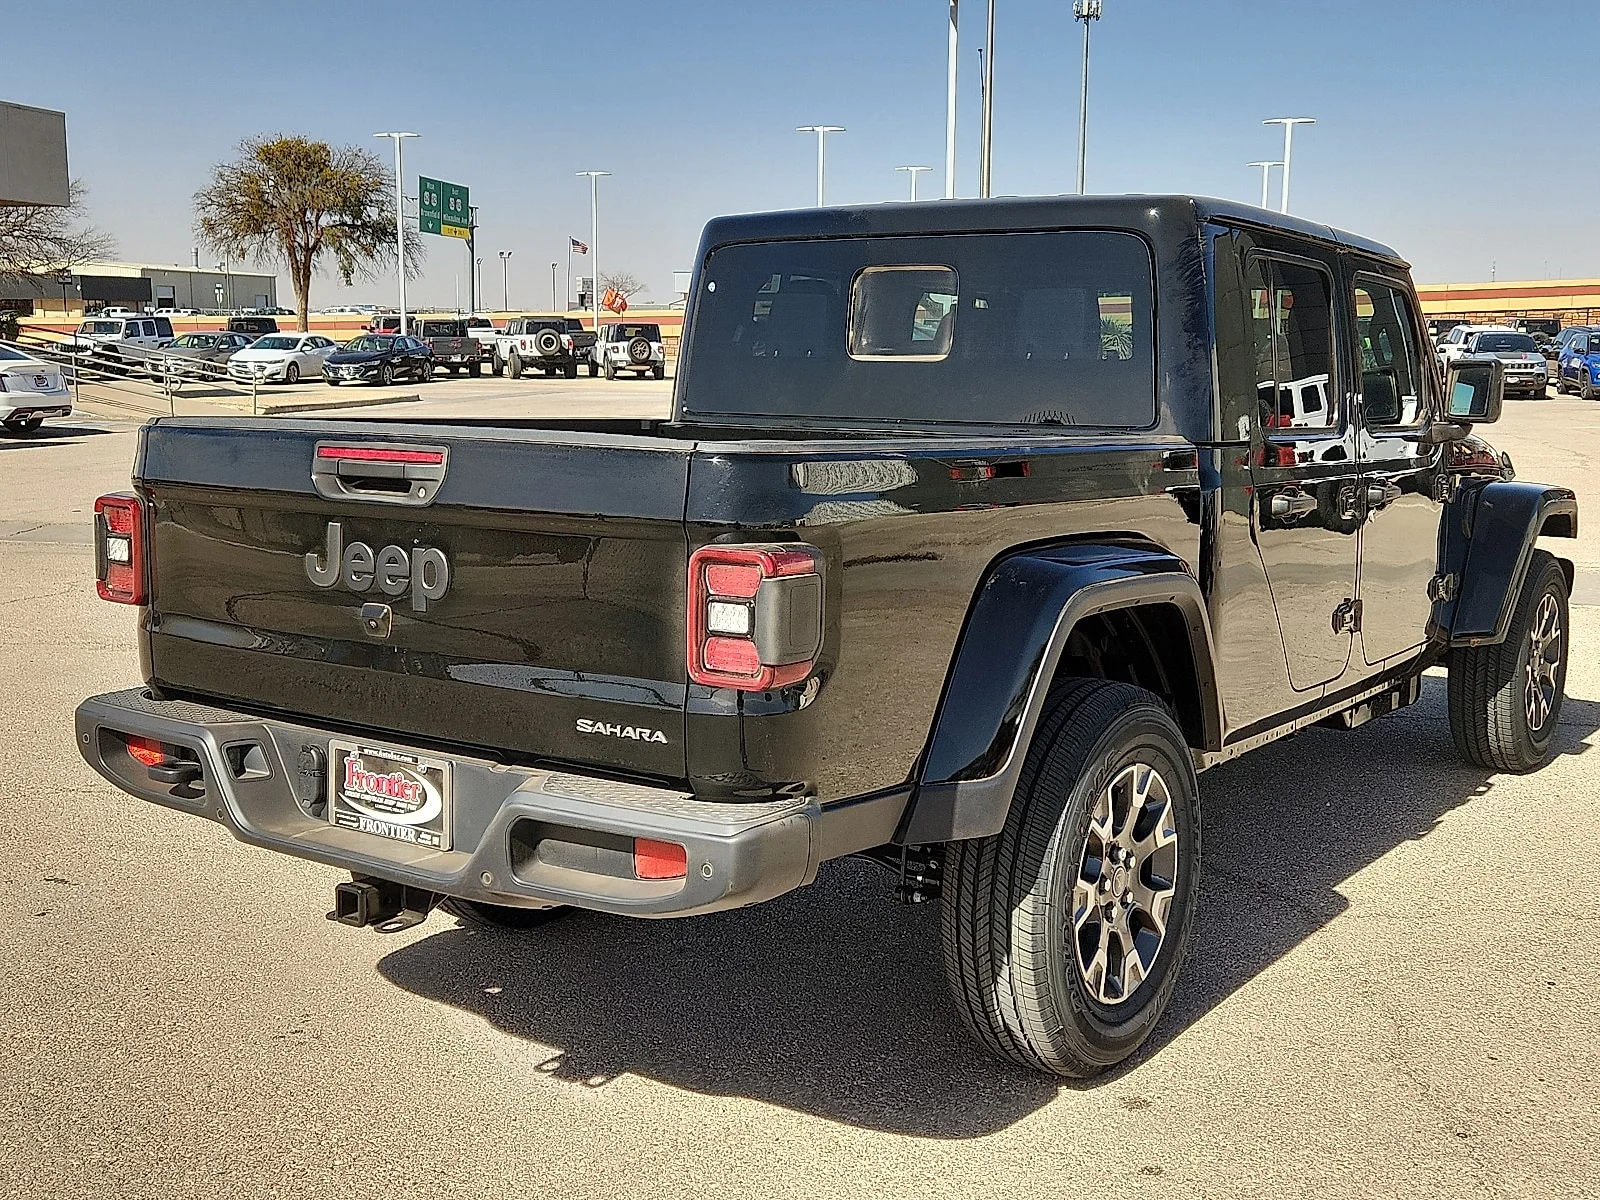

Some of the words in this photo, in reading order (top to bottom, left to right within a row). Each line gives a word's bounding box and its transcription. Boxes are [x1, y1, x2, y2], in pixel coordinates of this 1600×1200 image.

[305, 522, 451, 612] Jeep
[575, 718, 669, 745] SAHARA
[345, 758, 421, 803] Frontier
[358, 816, 416, 844] FRONTIER
